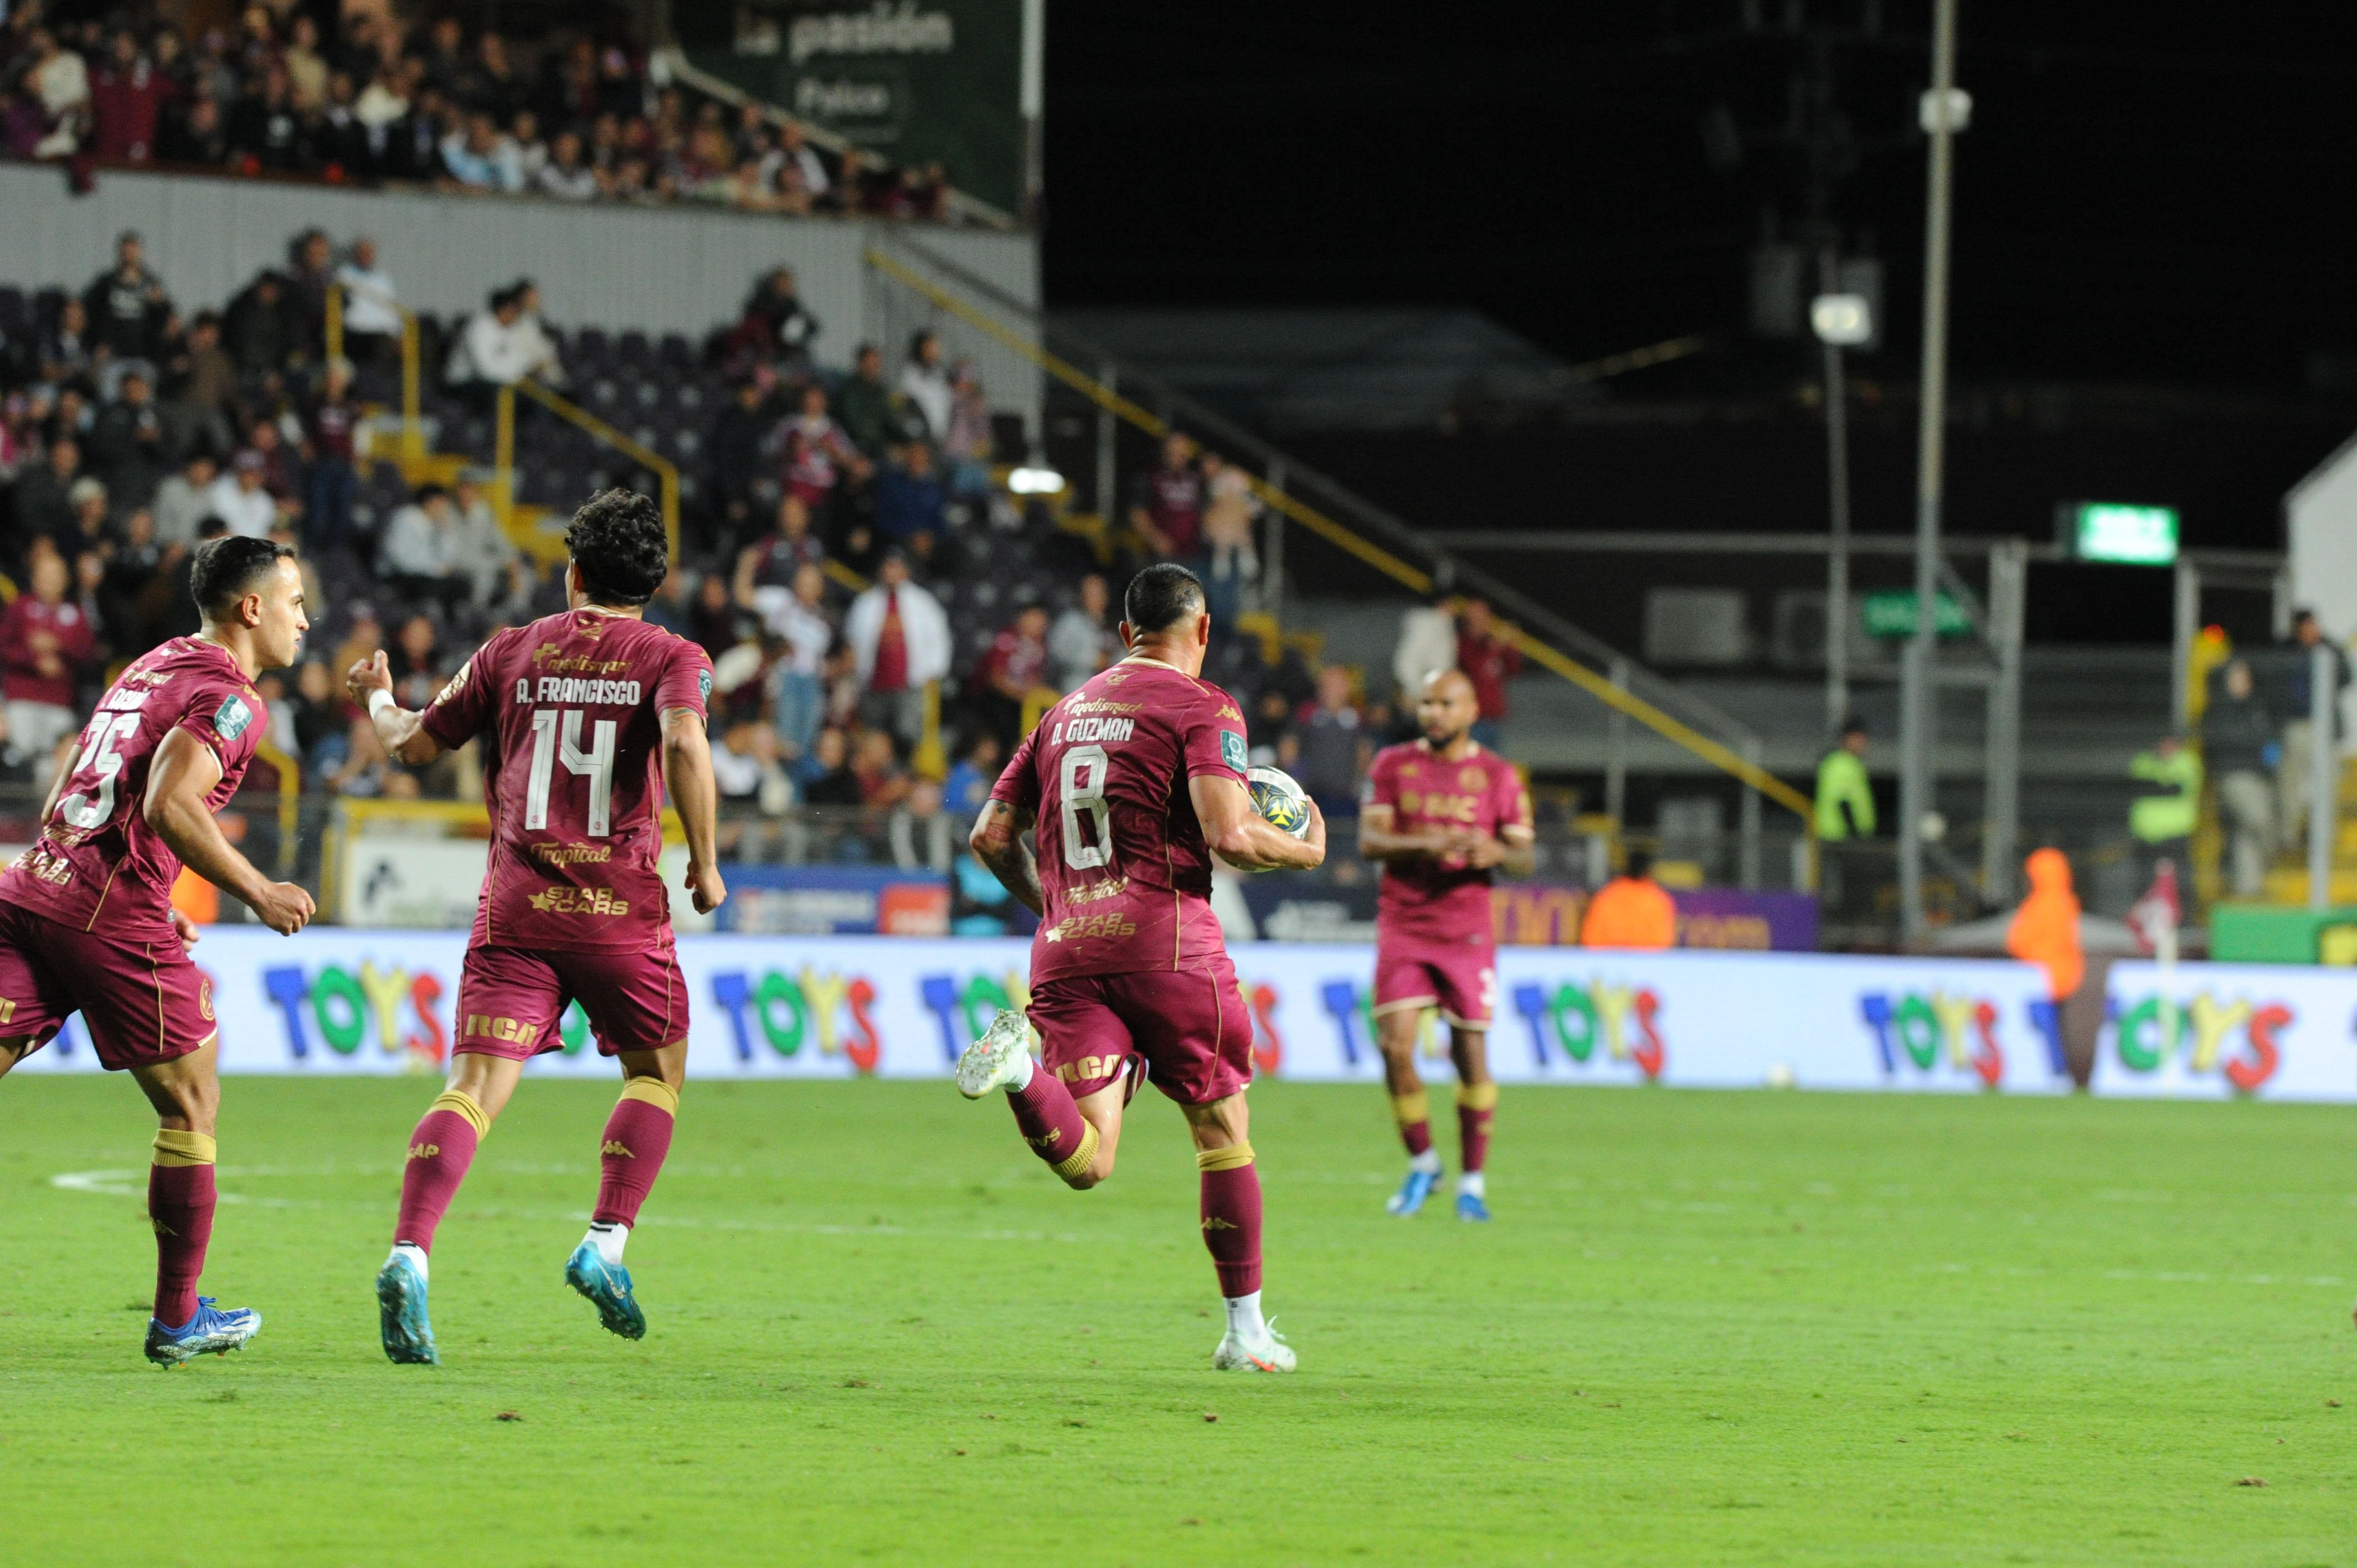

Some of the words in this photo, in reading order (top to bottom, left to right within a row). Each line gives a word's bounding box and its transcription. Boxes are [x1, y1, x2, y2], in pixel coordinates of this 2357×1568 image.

[516, 678, 533, 704] A.
[537, 677, 641, 705] FRANCISCO
[1069, 697, 1143, 717] medismart
[1066, 718, 1135, 742] GUZMAN
[524, 709, 617, 837] 14
[1060, 744, 1113, 871] 8
[531, 842, 611, 869] Tropical
[546, 886, 614, 901] STAR
[554, 899, 629, 916] CARS
[1058, 912, 1124, 931] STAR
[1066, 923, 1136, 939] CARS
[265, 960, 444, 1064] TOYS
[711, 962, 881, 1072] TOYS
[466, 1014, 538, 1048] RCA
[1512, 978, 1665, 1079] TOYS
[1859, 989, 2004, 1084] TOYS
[2107, 993, 2294, 1091] OYS
[1055, 1054, 1121, 1084] RCA
